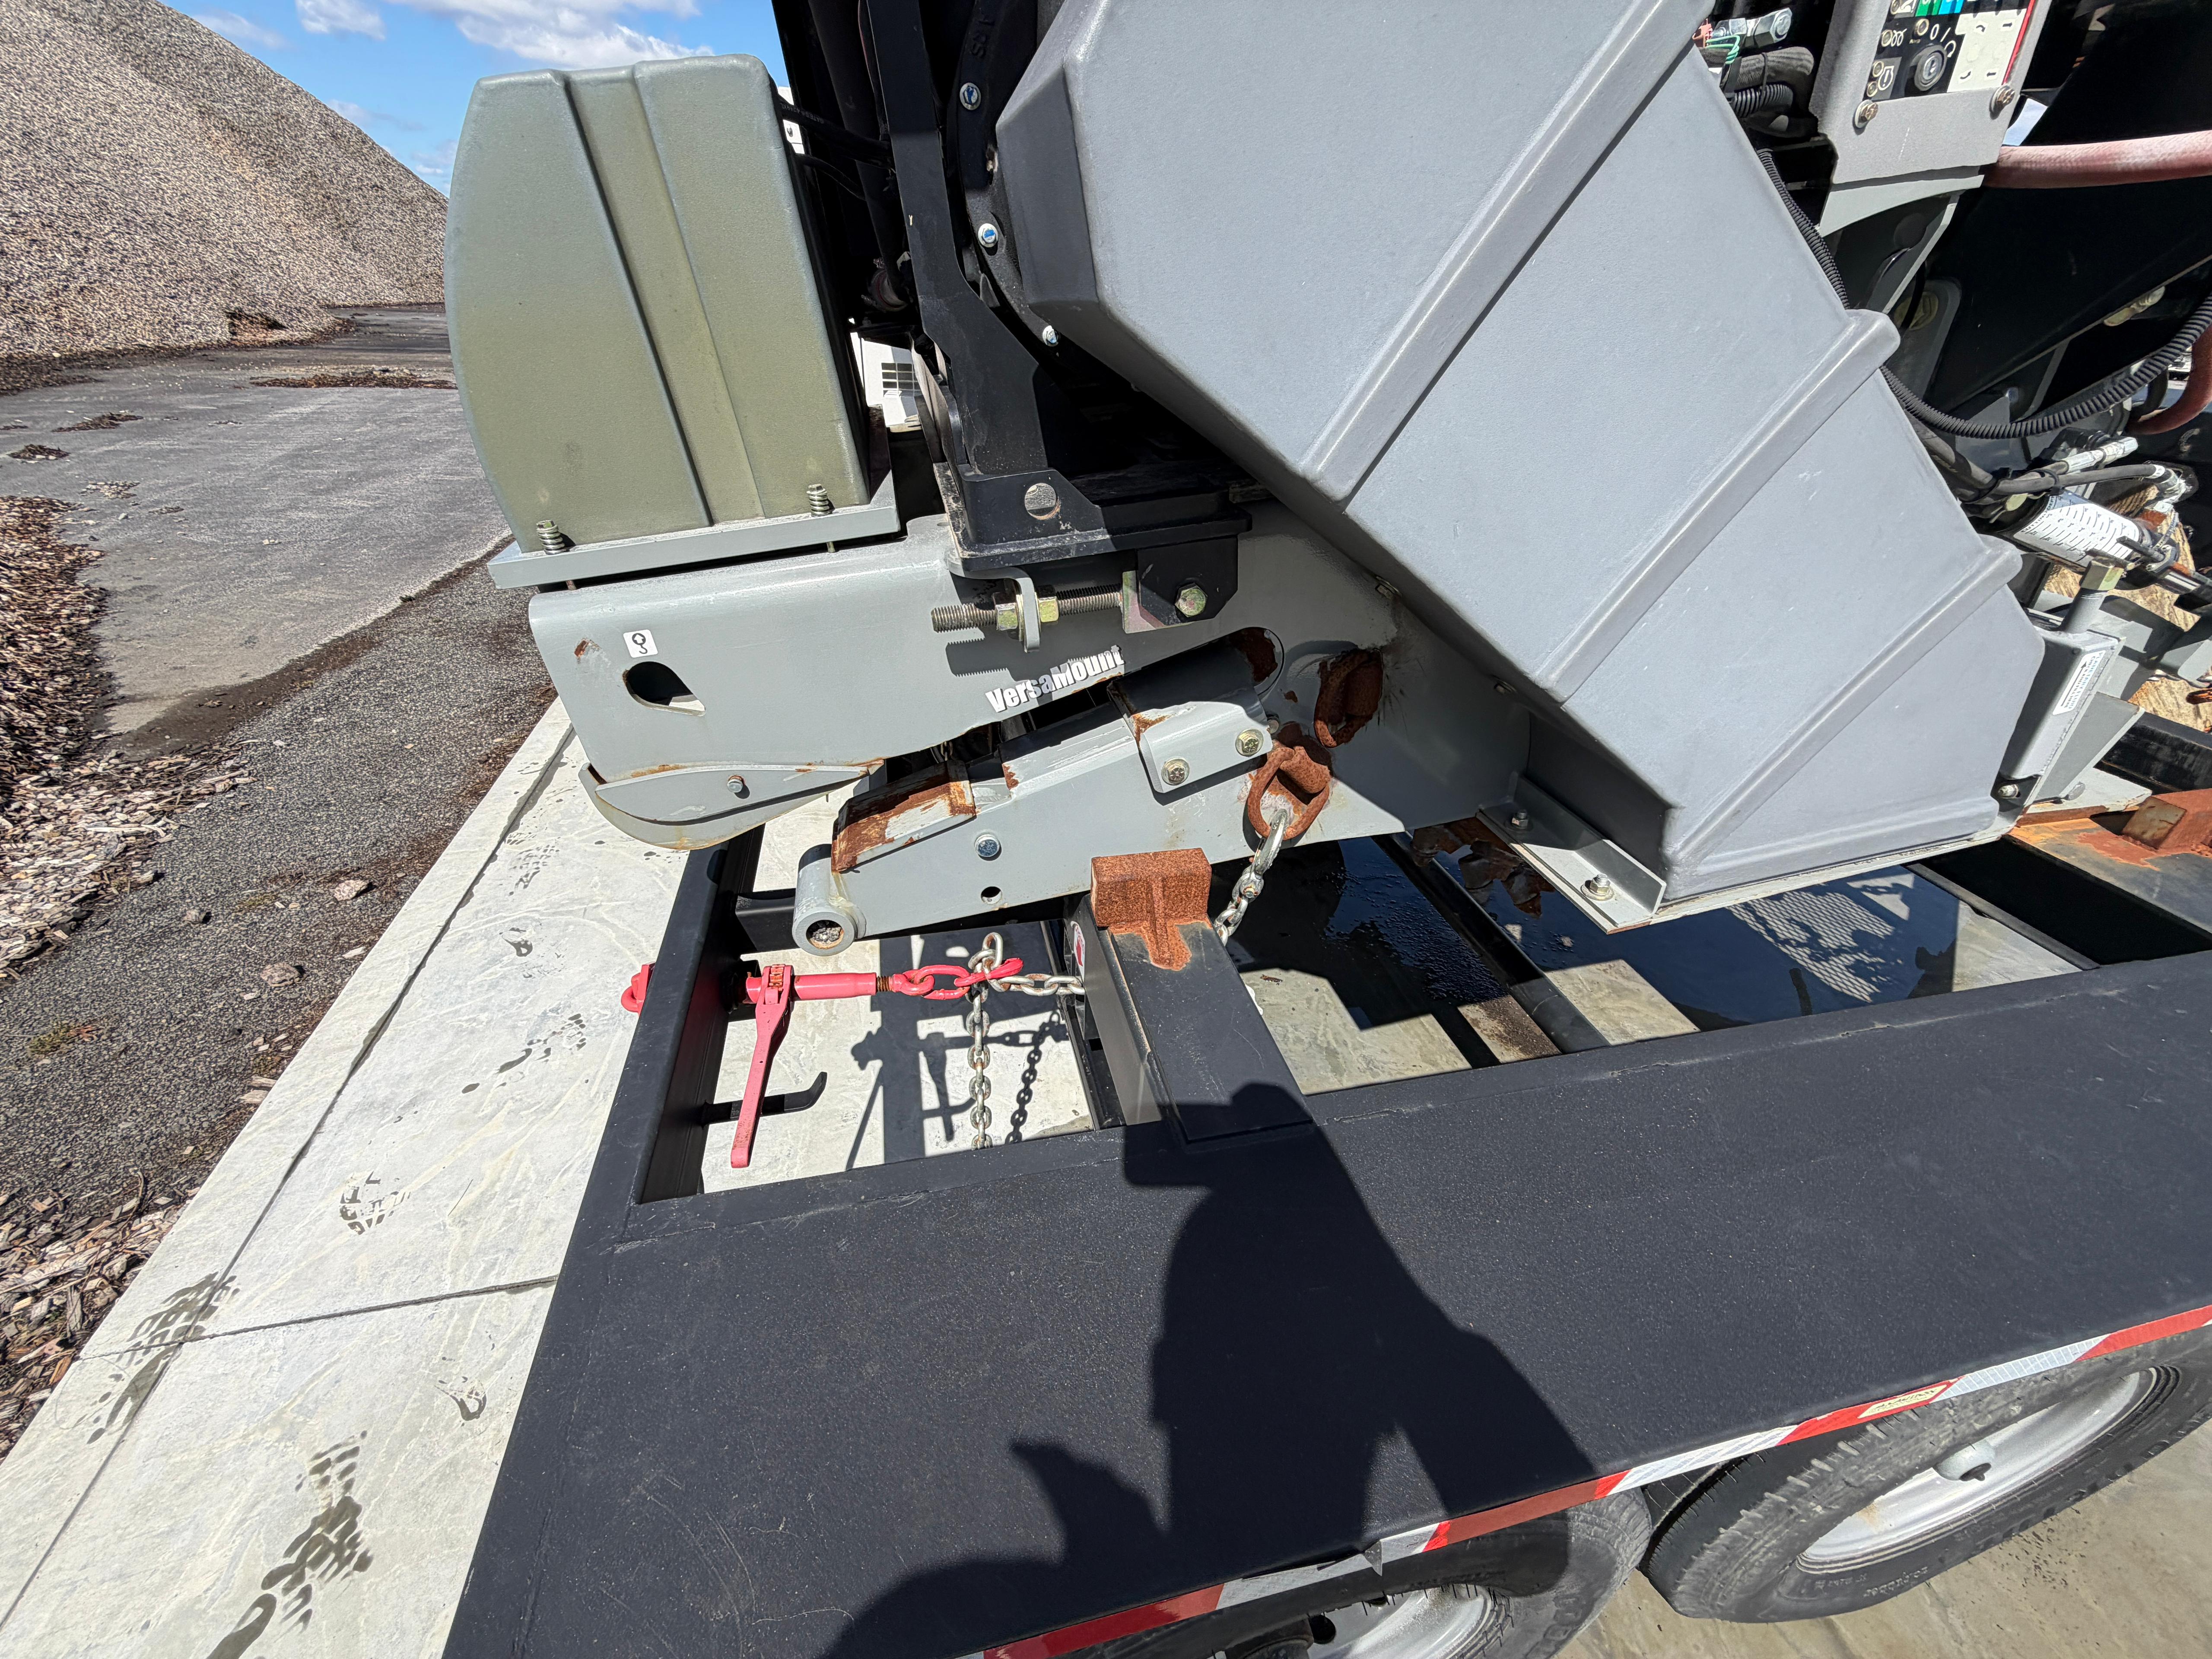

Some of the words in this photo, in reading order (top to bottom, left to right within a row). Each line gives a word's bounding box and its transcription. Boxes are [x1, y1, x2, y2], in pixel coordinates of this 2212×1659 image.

[985, 645, 1125, 713] VersaMount
[2079, 652, 2103, 689] PLANETARY
[2069, 691, 2082, 709] FLUID
